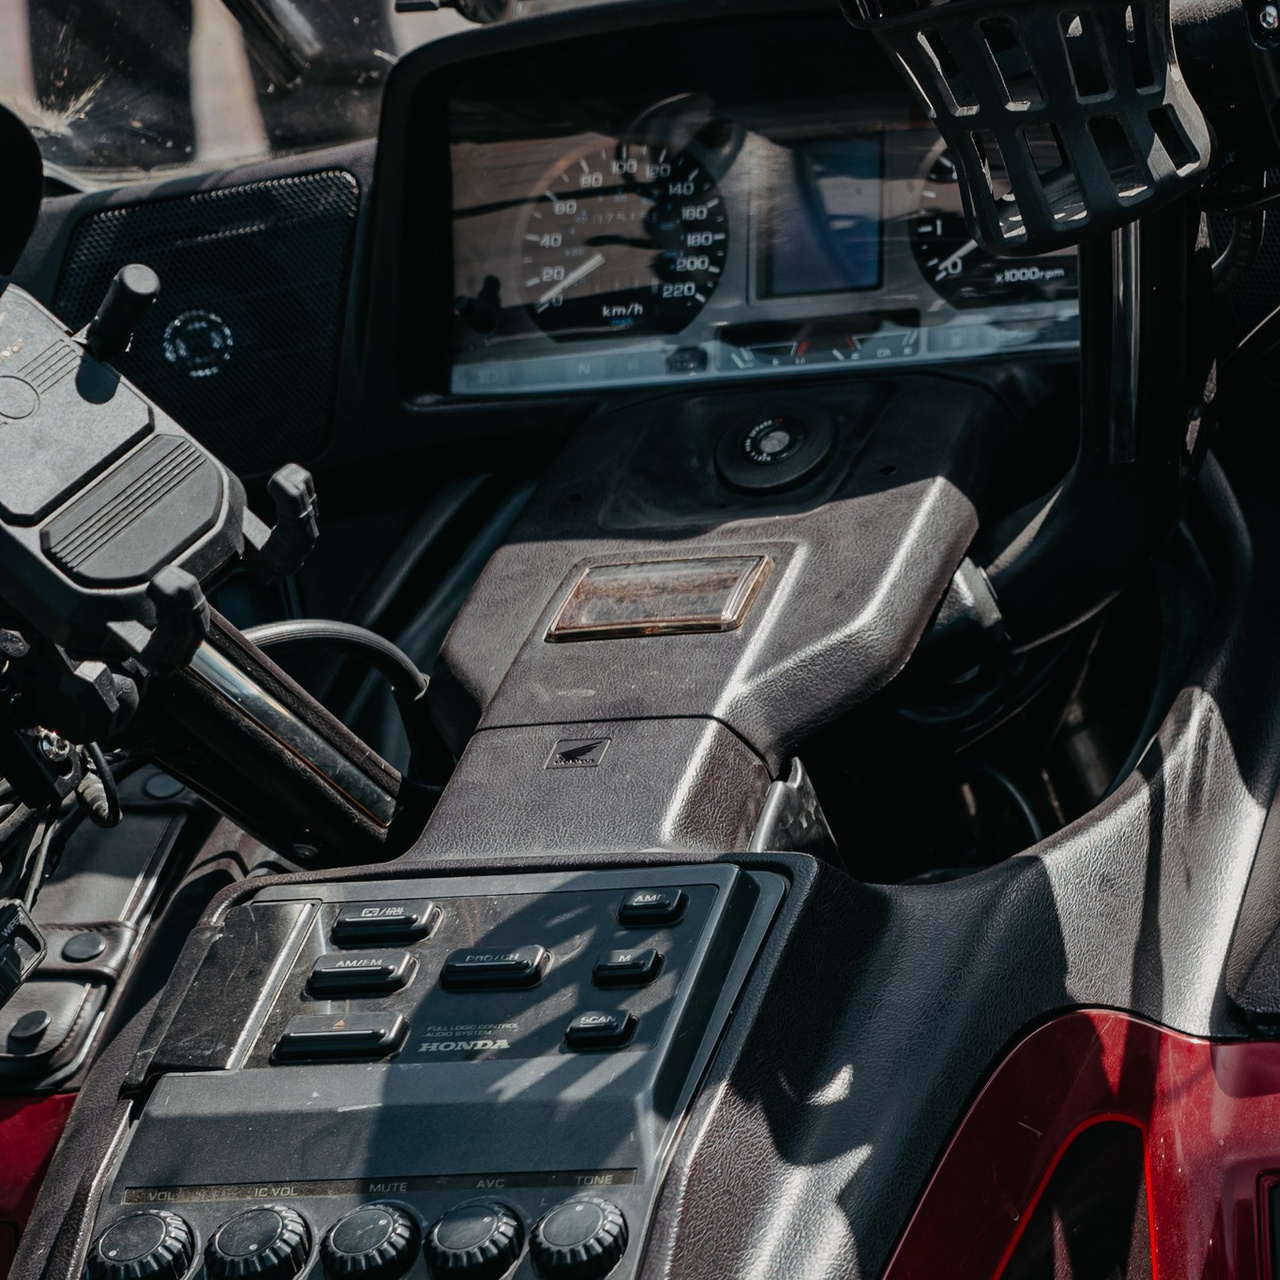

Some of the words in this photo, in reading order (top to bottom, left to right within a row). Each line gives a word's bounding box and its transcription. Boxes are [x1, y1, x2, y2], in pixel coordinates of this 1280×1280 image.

[611, 159, 638, 174] 100
[645, 162, 671, 178] 120
[580, 173, 603, 188] 80
[669, 181, 694, 196] 140
[554, 200, 577, 215] 60
[682, 205, 708, 220] 160
[539, 233, 562, 248] 40
[687, 231, 713, 247] 180
[676, 256, 709, 272] 200
[542, 266, 565, 281] 20
[662, 281, 696, 298] 220
[551, 294, 564, 306] 0
[602, 304, 643, 317] km/h
[335, 959, 383, 968] AM/FM
[618, 954, 632, 962] M
[580, 1015, 617, 1024] SCAN
[418, 1039, 510, 1052] HONDA
[369, 1182, 408, 1193] MUTE
[476, 1178, 506, 1189] AVC
[575, 1174, 614, 1186] TONE
[254, 1188, 272, 1197] IC
[272, 1186, 298, 1197] VOL
